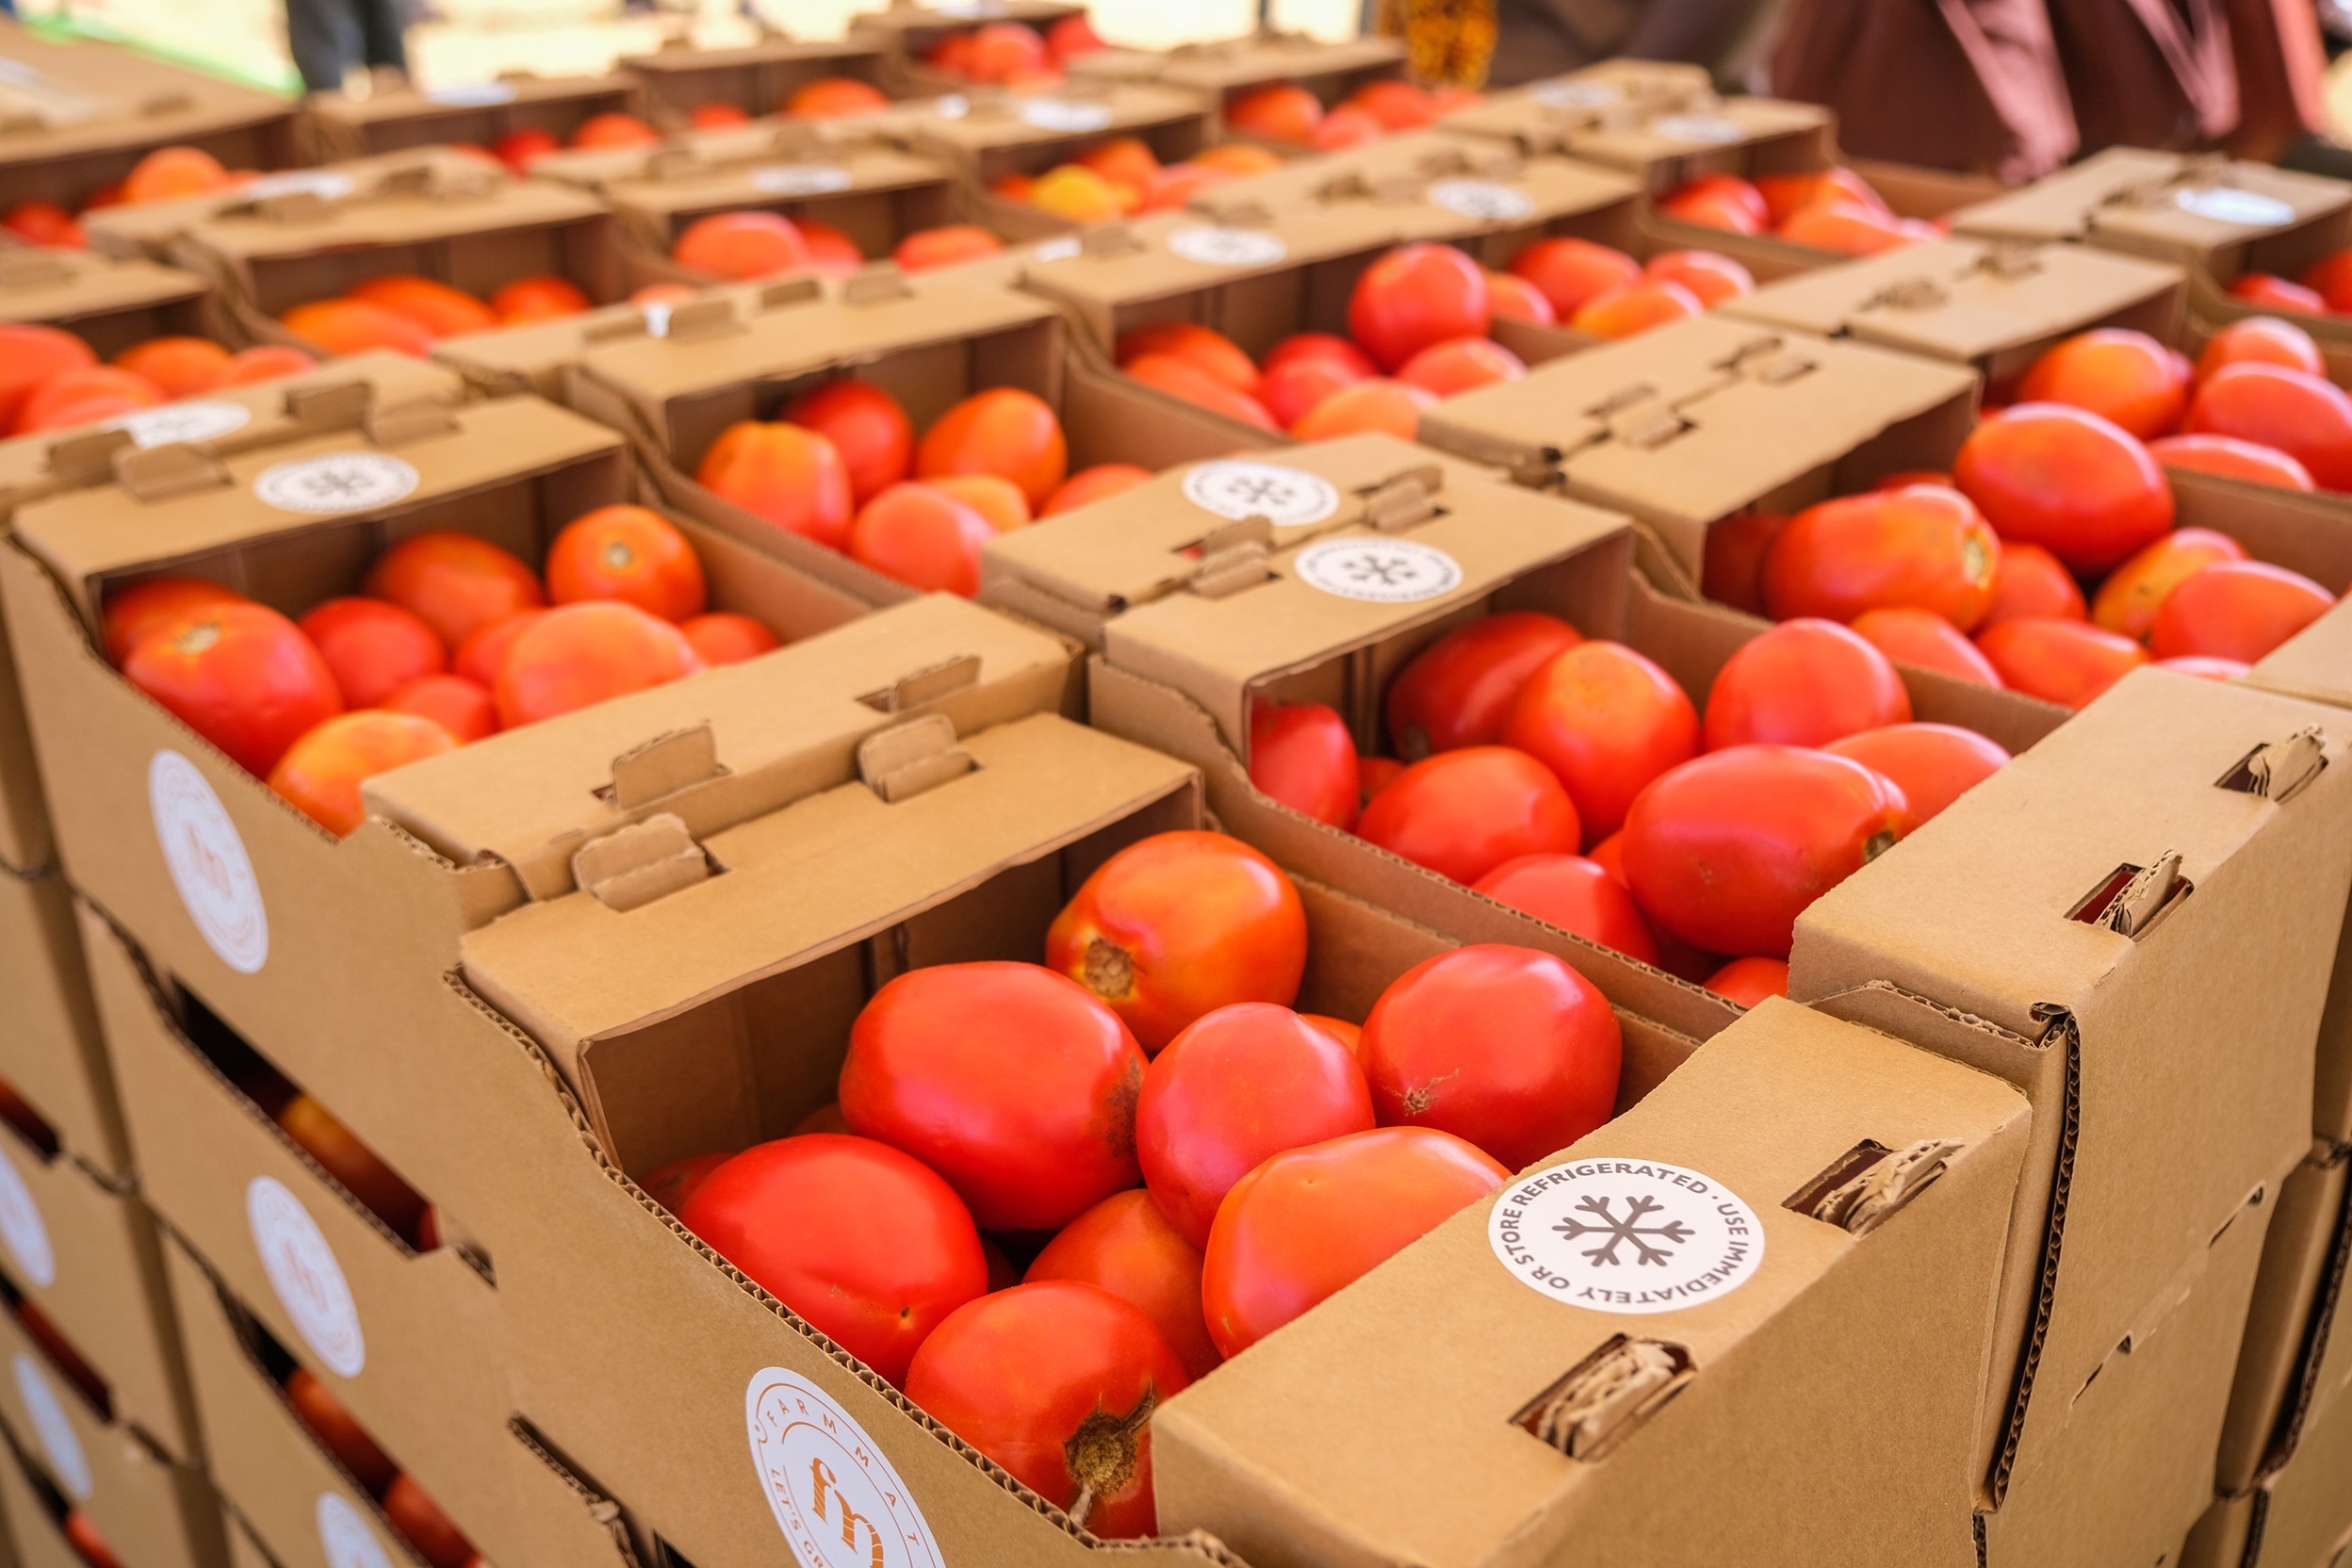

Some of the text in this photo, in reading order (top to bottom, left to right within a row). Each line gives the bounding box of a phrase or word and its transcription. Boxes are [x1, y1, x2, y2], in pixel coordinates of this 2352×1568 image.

[1499, 1163, 1749, 1304] USE IMMEDIATELY OR STORE REFRIGERATED
[771, 1467, 802, 1531] LET'S
